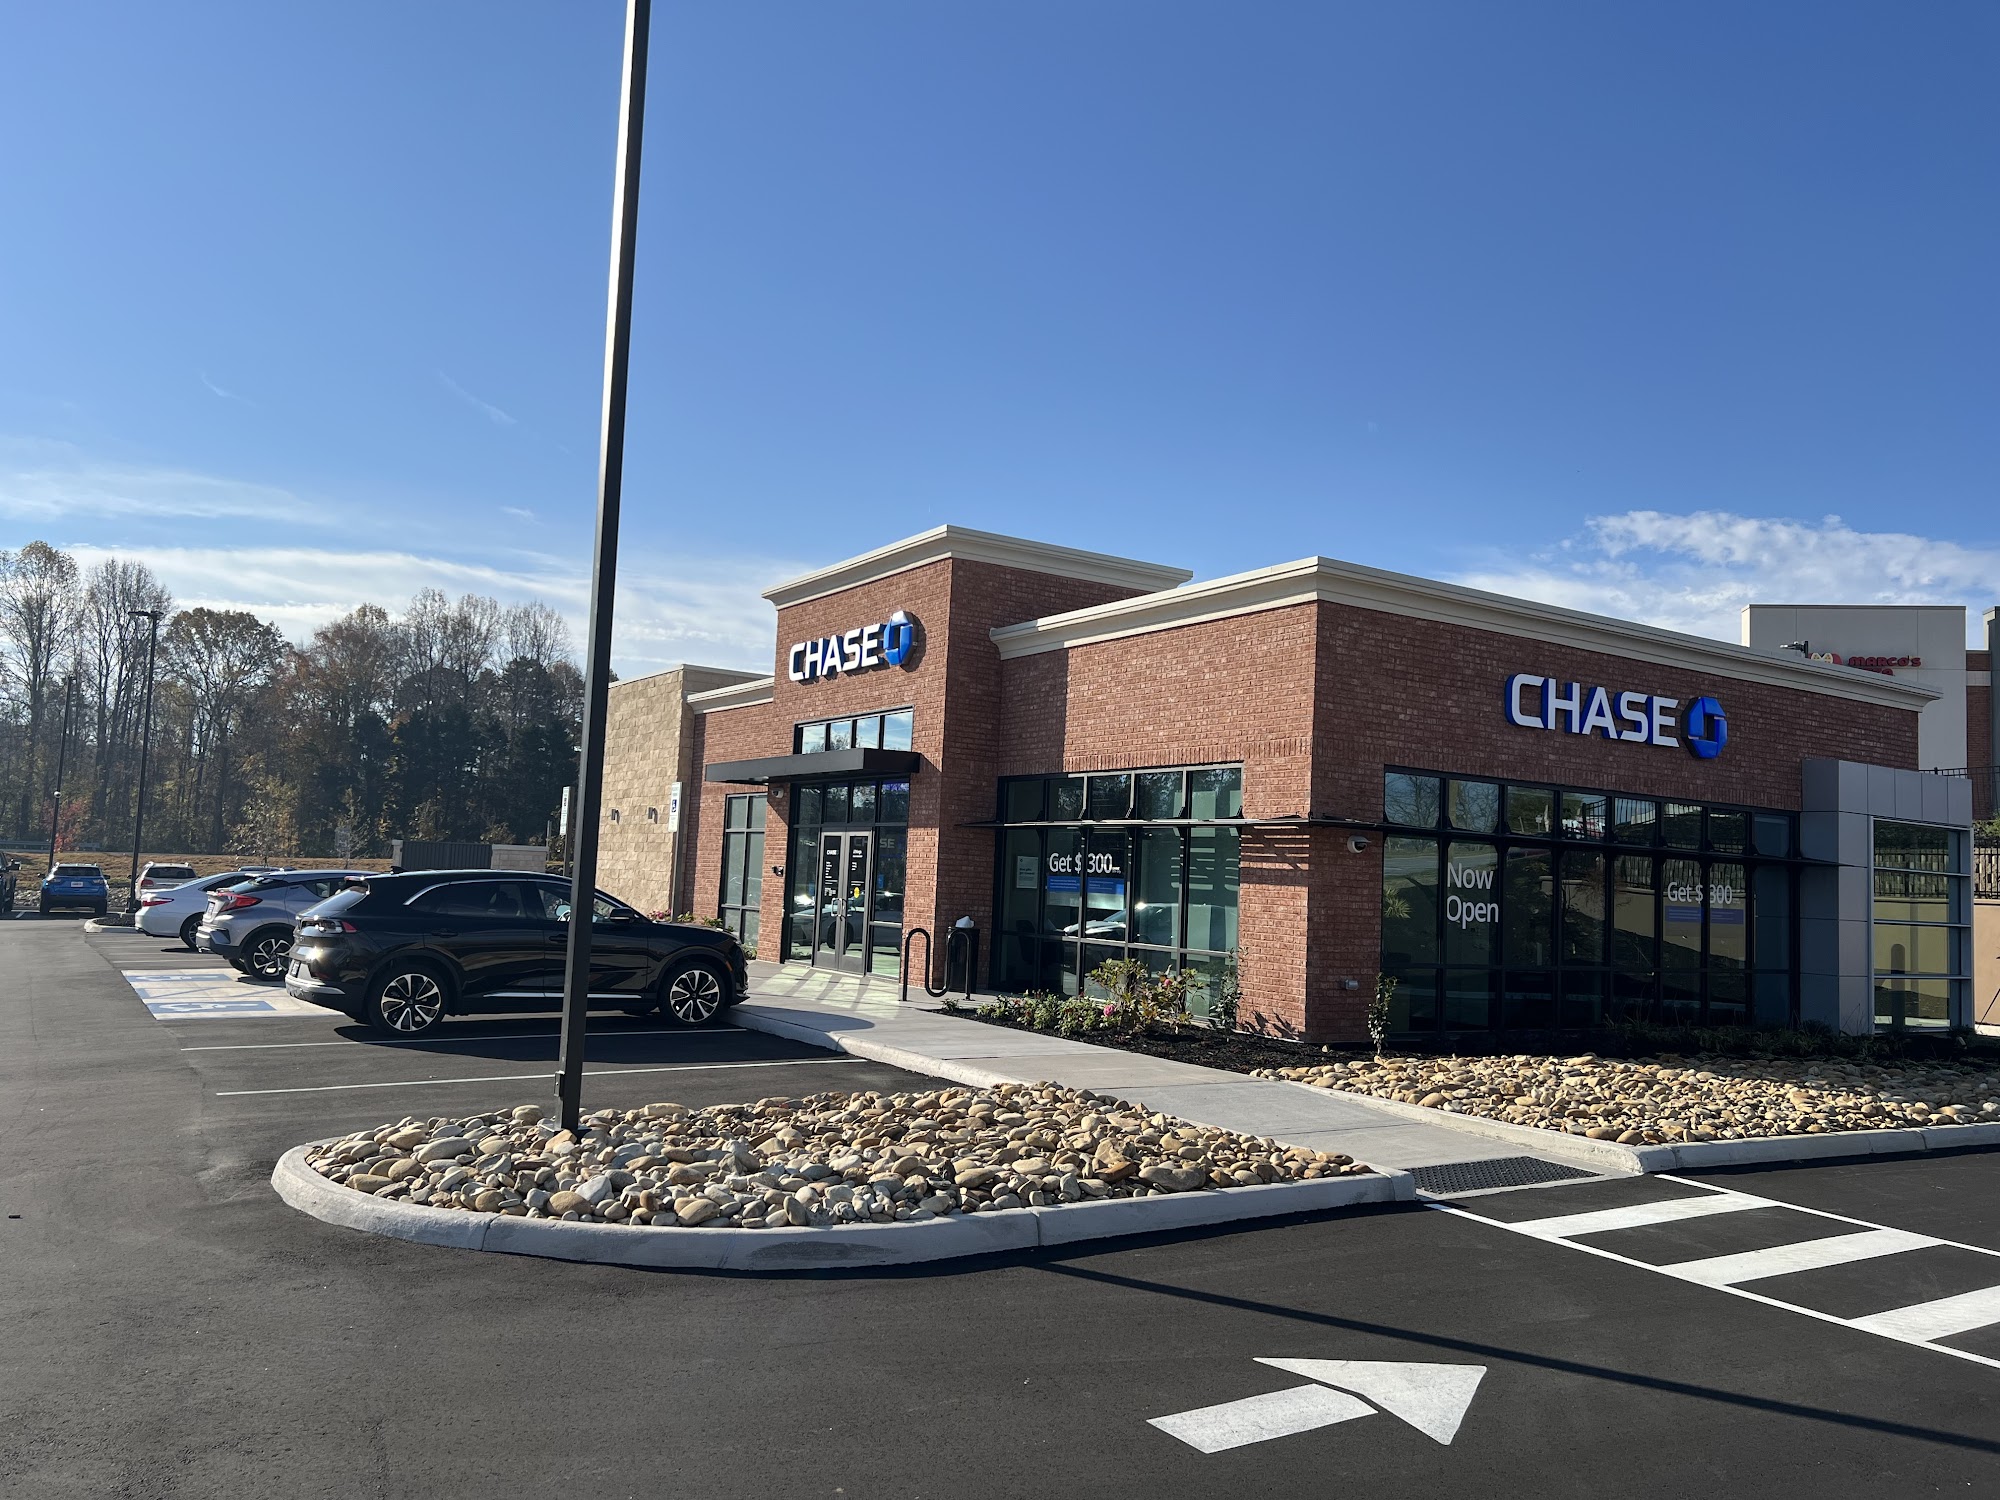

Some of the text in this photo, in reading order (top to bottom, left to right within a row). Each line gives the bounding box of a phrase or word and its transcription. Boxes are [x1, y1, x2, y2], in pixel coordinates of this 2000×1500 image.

[788, 624, 881, 681] CHASE
[1506, 673, 1680, 748] CHASE
[853, 837, 895, 849] CHSE
[1049, 853, 1072, 872] Get
[1447, 862, 1494, 890] Now
[1667, 881, 1693, 902] Get
[1446, 895, 1499, 930] Open
